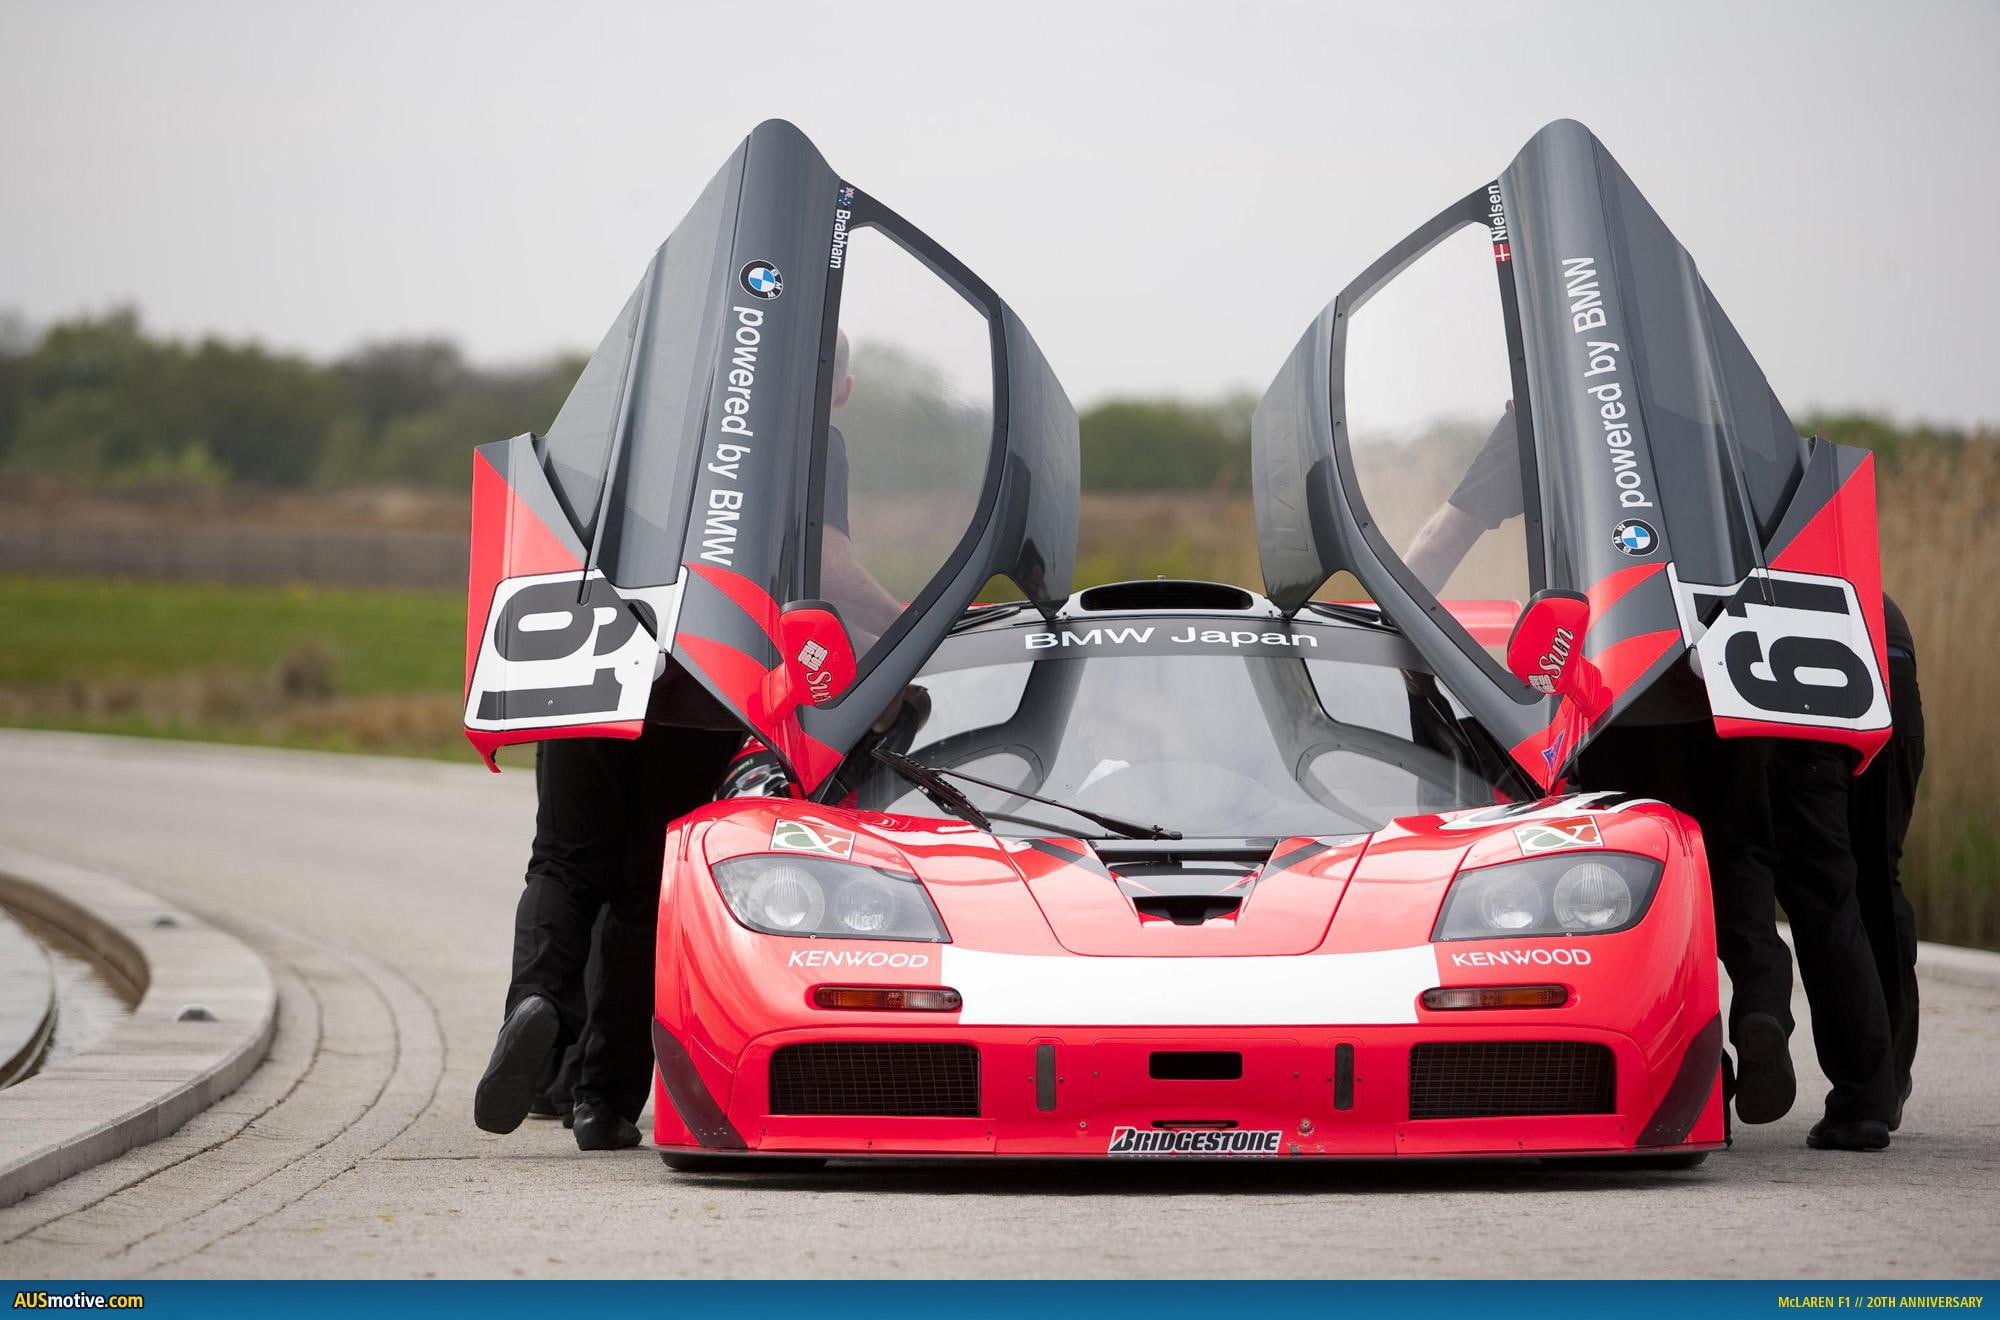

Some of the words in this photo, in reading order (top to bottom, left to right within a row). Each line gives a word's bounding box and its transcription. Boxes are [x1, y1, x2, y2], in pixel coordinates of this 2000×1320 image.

[829, 208, 851, 269] Brabham
[1487, 184, 1508, 242] Nielsen
[1561, 257, 1607, 334] BMW
[720, 305, 764, 437] powered
[1583, 340, 1620, 378] by
[707, 443, 751, 480] by
[1587, 382, 1653, 508] powered
[700, 488, 744, 567] BMW
[476, 576, 659, 720] 61
[1024, 626, 1155, 650] BMW
[1170, 626, 1318, 648] Japan
[1538, 626, 1575, 680] Sun
[1692, 575, 1875, 720] 61
[805, 670, 833, 703] Sun
[787, 949, 929, 969] KENWOOD
[1451, 947, 1593, 967] KENWOOD
[1109, 1127, 1281, 1152] BRIDGESTONE
